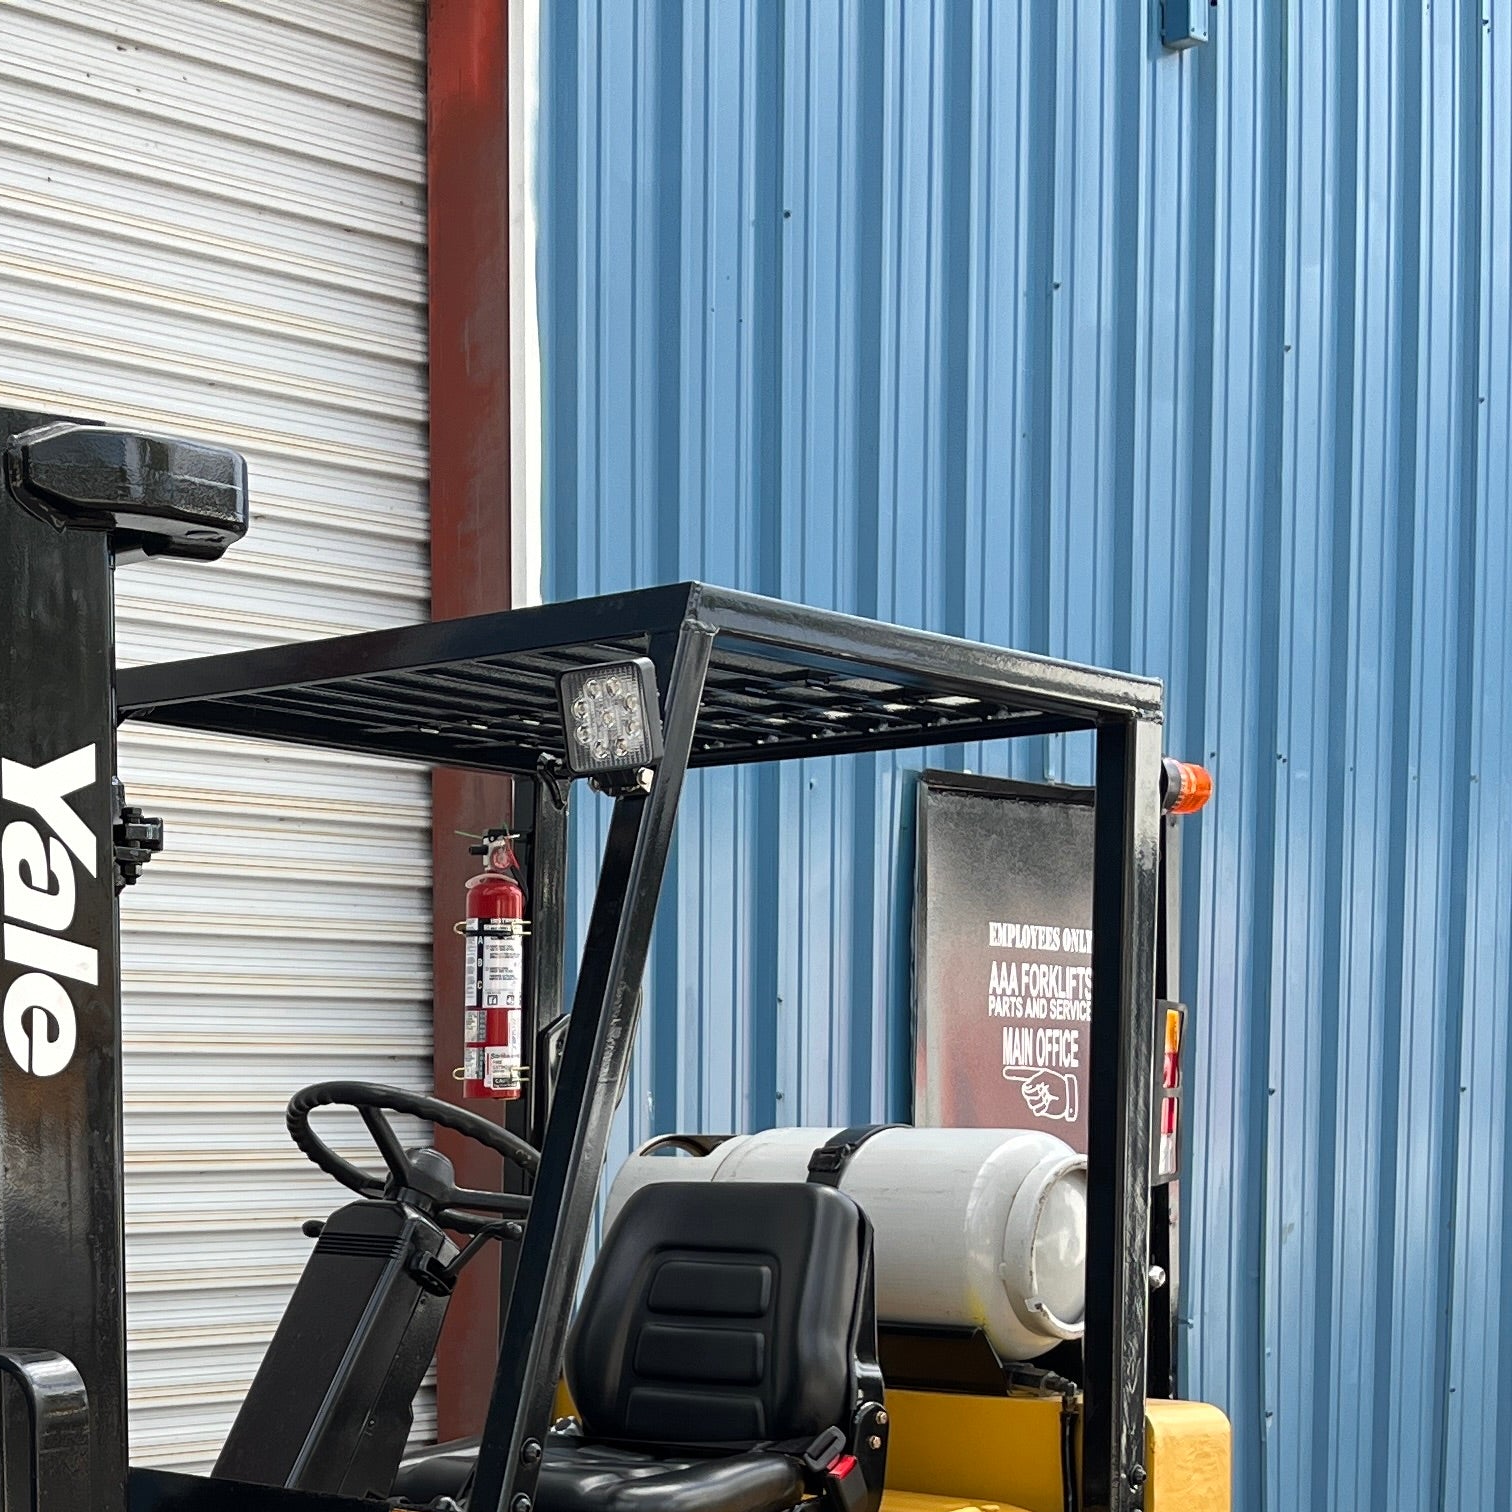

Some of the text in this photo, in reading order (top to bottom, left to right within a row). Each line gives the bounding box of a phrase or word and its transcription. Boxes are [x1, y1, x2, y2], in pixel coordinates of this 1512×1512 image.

[1, 742, 99, 1077] Yale
[989, 921, 1092, 954] EMPLOYEES ONLY
[988, 960, 1092, 1000] AAA FORKLIFTS
[988, 995, 1023, 1018] PARTS
[1025, 997, 1048, 1019] AND
[1003, 1026, 1079, 1067] MAIN OFFICE
